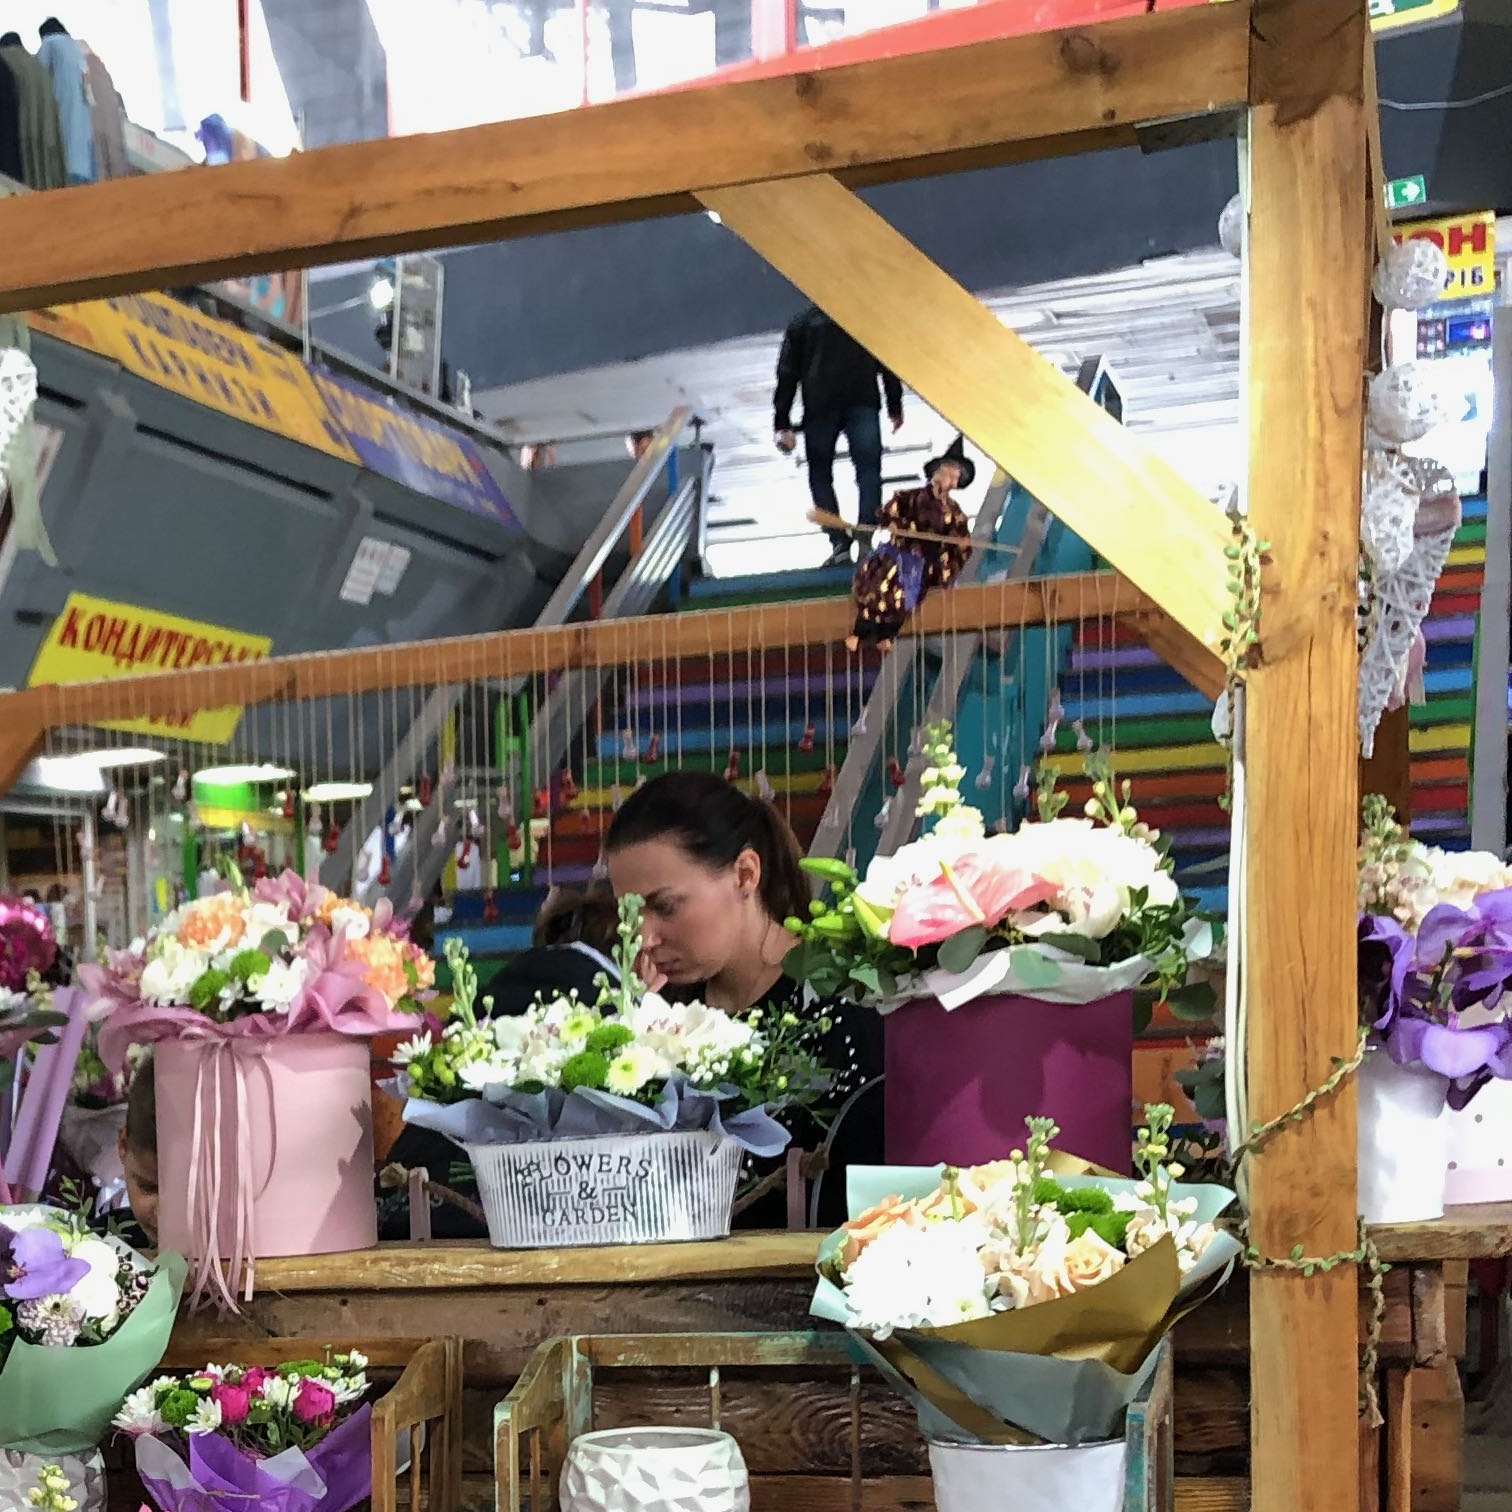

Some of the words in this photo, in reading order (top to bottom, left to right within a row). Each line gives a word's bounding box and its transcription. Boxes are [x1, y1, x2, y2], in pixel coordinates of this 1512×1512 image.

[519, 1152, 652, 1187] FLOWERS
[578, 1180, 597, 1200] &
[542, 1203, 637, 1226] GARDEN
